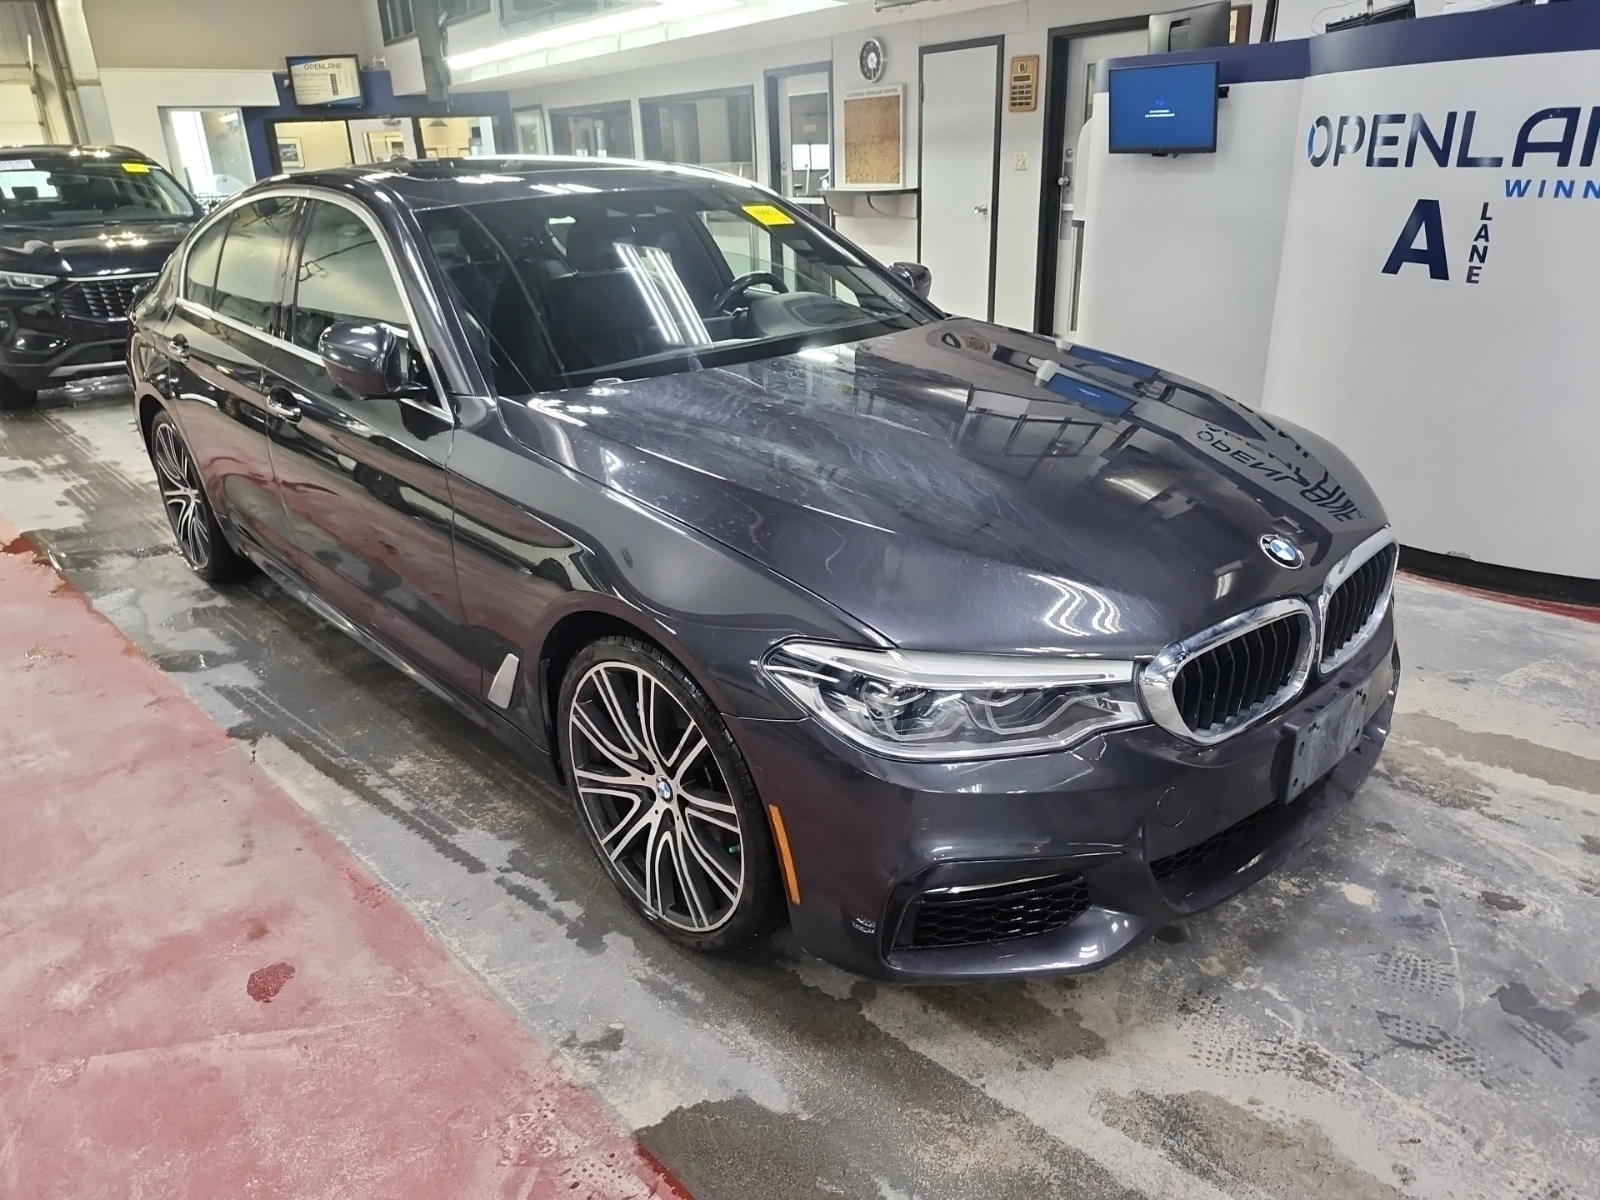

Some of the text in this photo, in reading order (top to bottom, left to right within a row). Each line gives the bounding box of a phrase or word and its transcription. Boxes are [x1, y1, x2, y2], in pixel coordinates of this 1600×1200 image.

[304, 62, 342, 70] OPENLANE
[1381, 198, 1493, 284] A LANE
